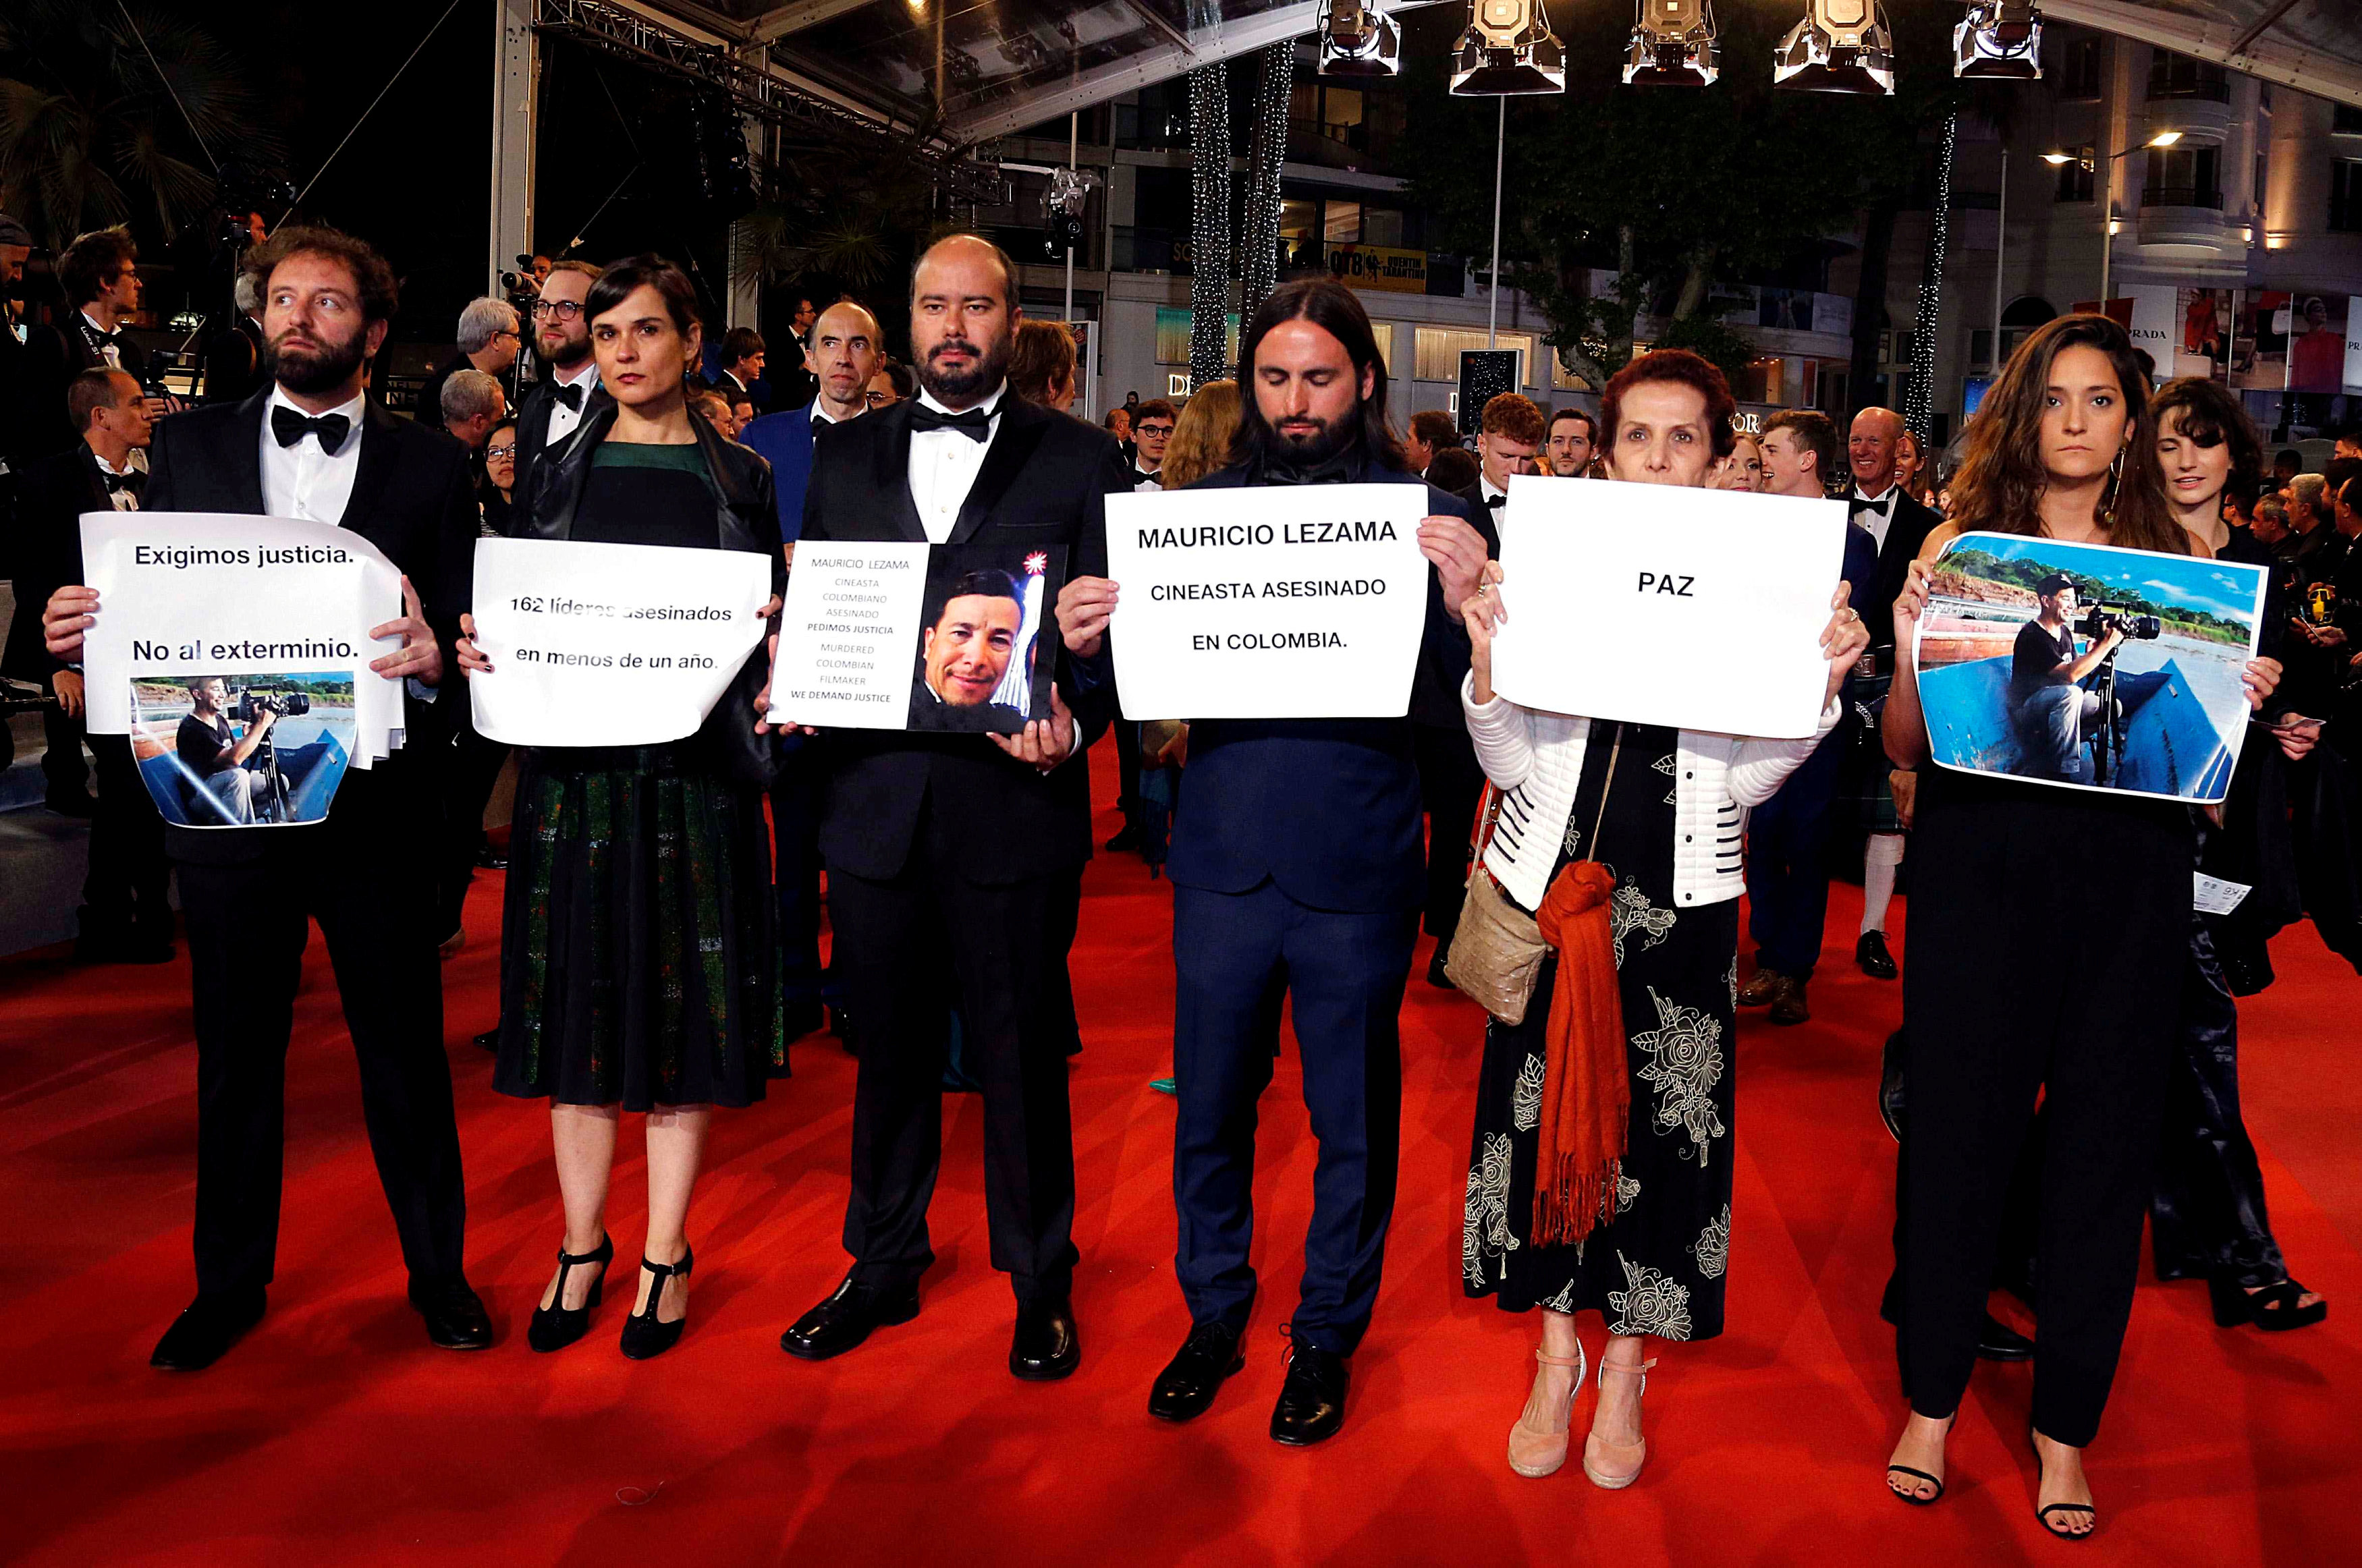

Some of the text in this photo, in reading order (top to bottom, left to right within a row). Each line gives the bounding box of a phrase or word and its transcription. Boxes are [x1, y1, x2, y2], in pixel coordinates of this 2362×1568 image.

[1388, 256, 1421, 269] QUENTIN
[1382, 266, 1426, 280] TARANTINO
[1138, 521, 1397, 549] MAURICIO LEZAMA
[136, 545, 354, 569] Exigimos justicia.
[811, 559, 910, 569] MAURICIO LEZAMA
[835, 578, 879, 587] CINEASTA
[1639, 572, 1695, 596] PAZ
[1151, 579, 1385, 600] CINEASTA ASESINADO
[511, 596, 543, 613] 162
[823, 593, 887, 603] COLOMBIANO
[826, 609, 879, 619] ASESINADO
[807, 623, 894, 634] PEDIMOS JUSTICIA
[1193, 632, 1347, 650] EN COLOMBIA.
[134, 638, 358, 661] No al exterminio.
[821, 644, 875, 654] MURDERED
[516, 649, 718, 669] en menos de un año.
[817, 659, 874, 670] COLOMBIAN
[820, 675, 867, 685] FILMAKER
[791, 691, 891, 702] WE DEMAND JUSTICE
